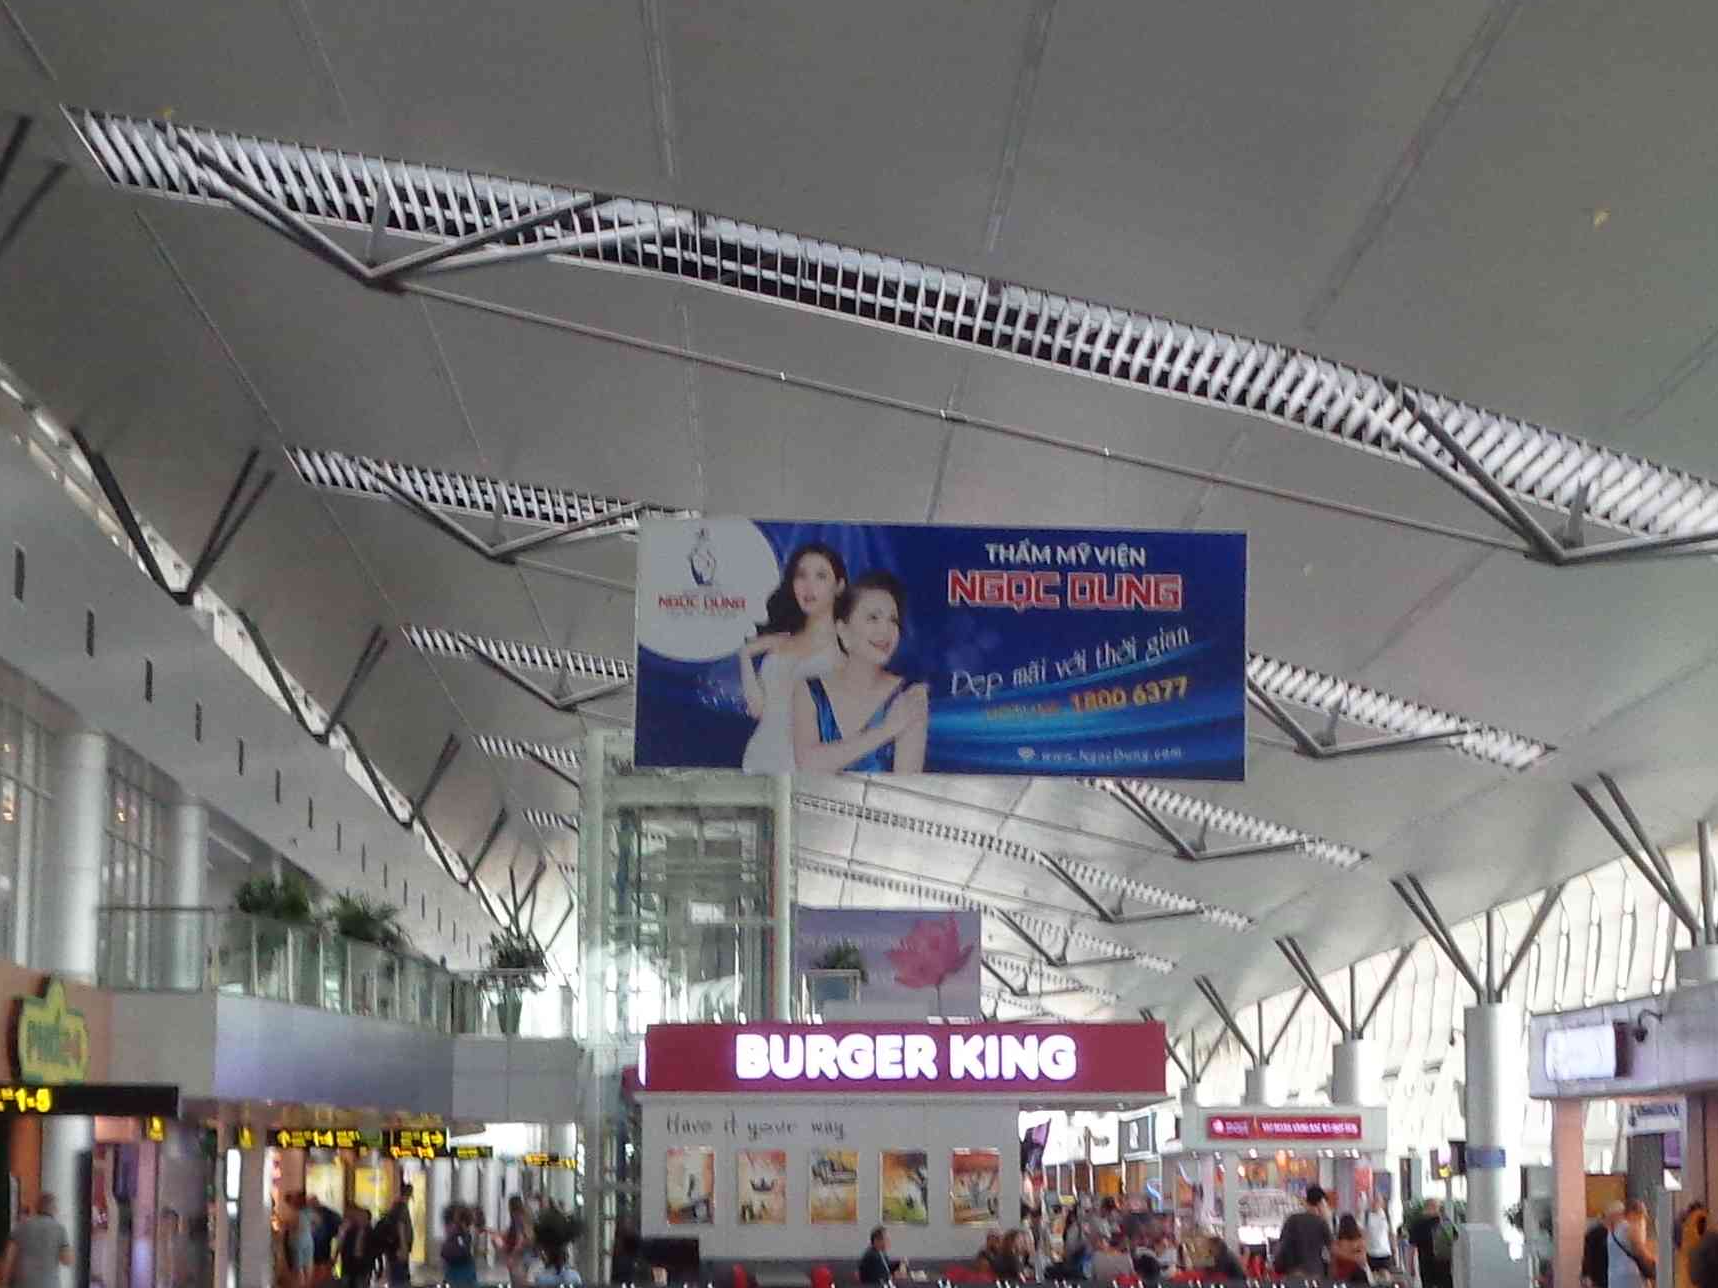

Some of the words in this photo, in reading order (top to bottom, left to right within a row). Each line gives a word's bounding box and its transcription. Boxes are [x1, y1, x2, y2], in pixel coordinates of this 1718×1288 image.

[1094, 541, 1146, 570] VIỆN
[948, 568, 1060, 613] NGỌC
[1068, 571, 1182, 611] DUNG
[1133, 676, 1189, 706] 6377
[735, 1033, 938, 1080] BURGER
[948, 1034, 1077, 1080] KING
[811, 1119, 845, 1140] way
